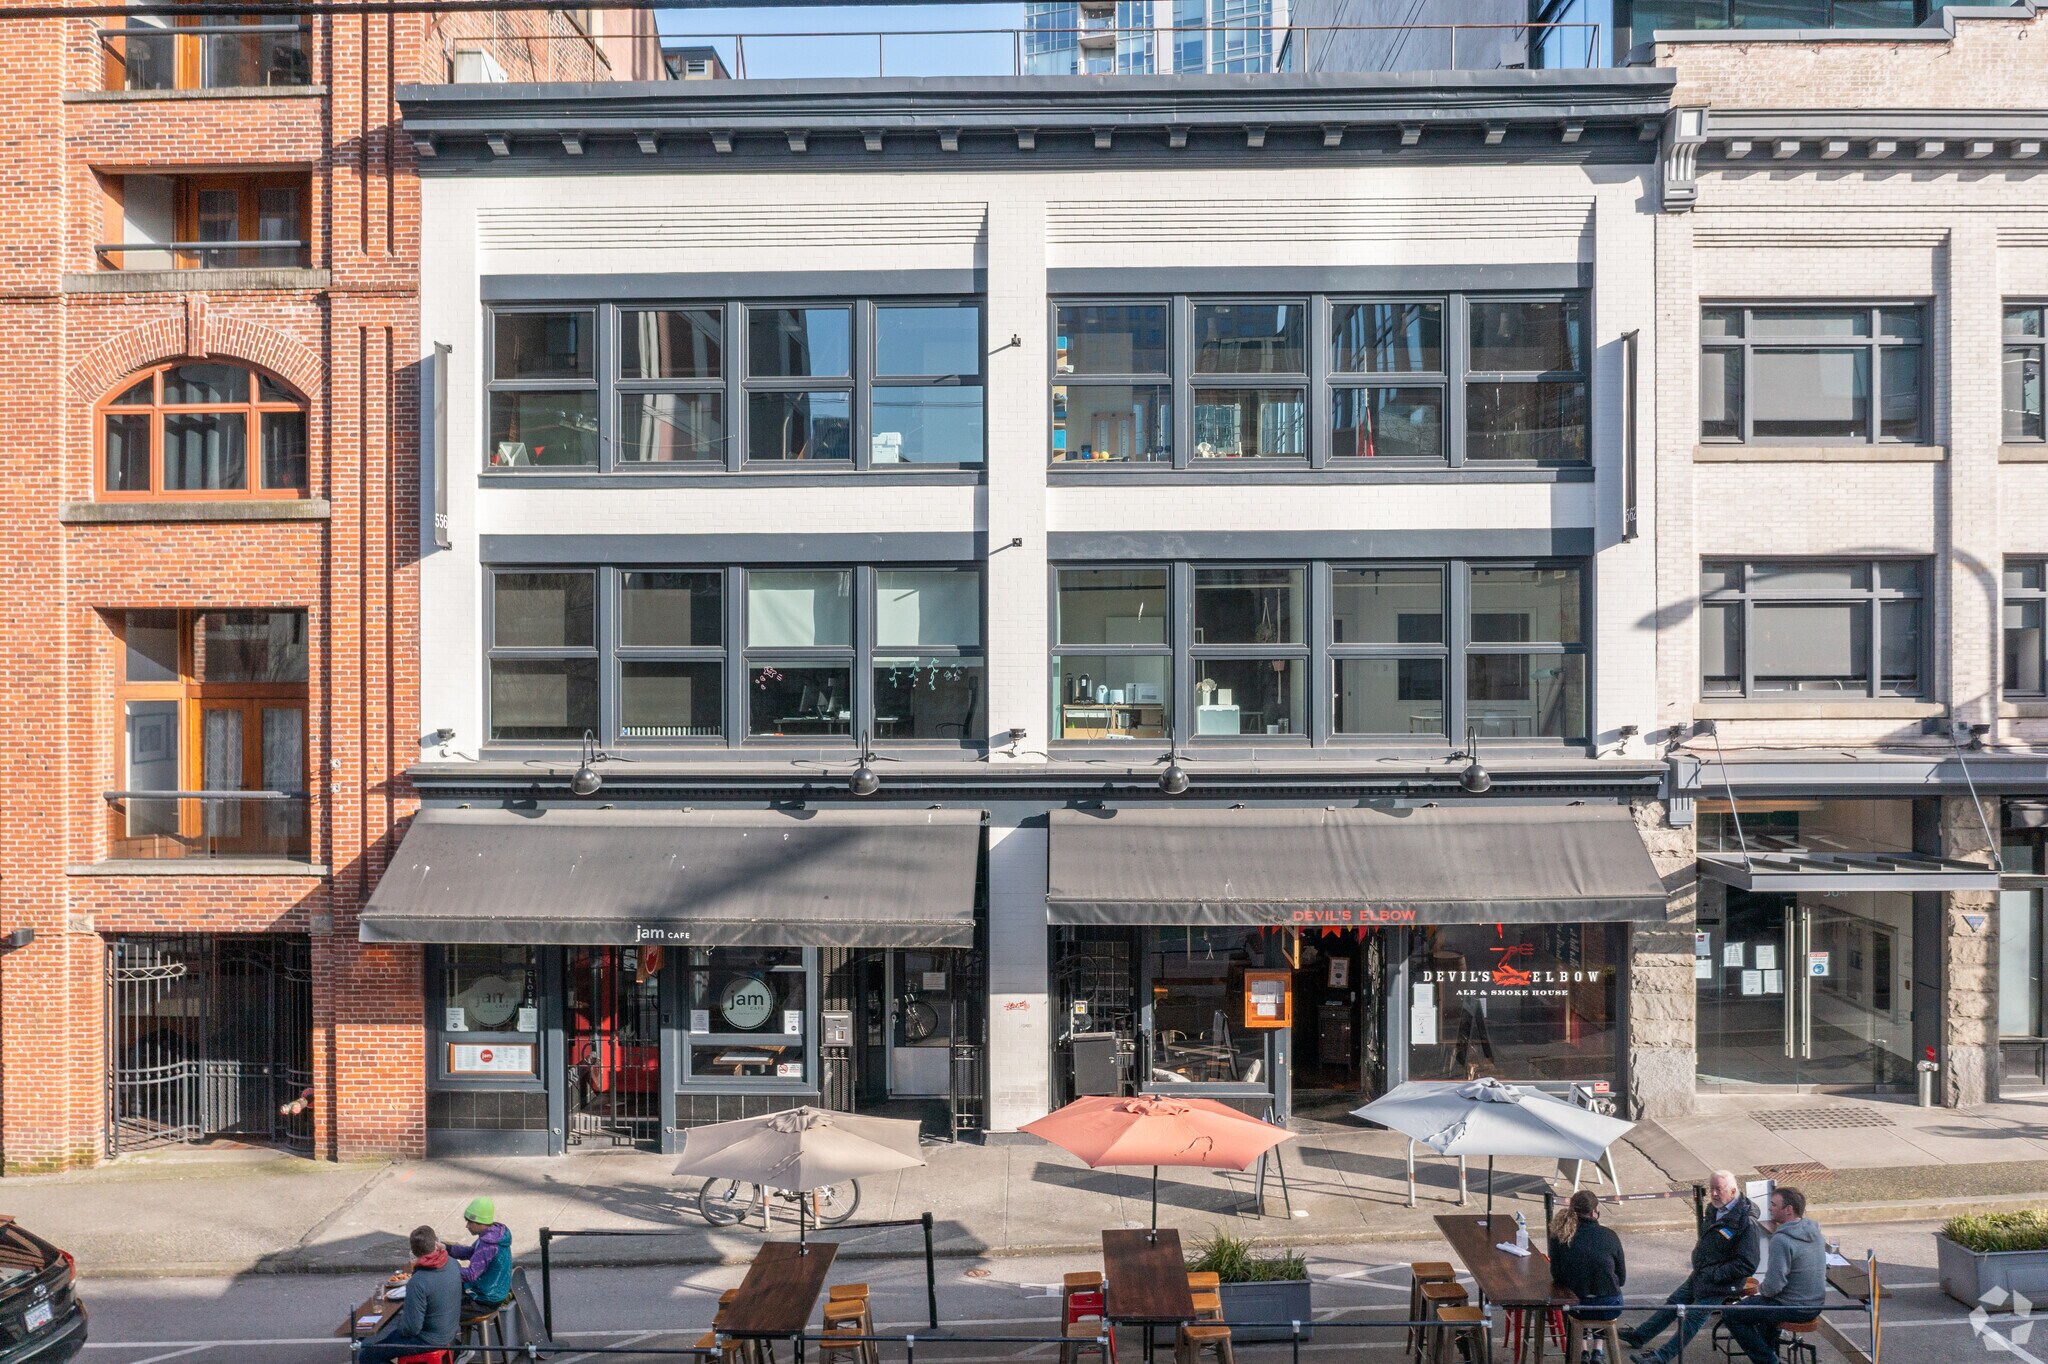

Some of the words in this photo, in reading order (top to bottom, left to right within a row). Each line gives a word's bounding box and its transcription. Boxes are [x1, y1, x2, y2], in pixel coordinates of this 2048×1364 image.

[435, 513, 448, 529] 556
[1293, 910, 1352, 921] DEVIL'S
[1359, 910, 1416, 921] ELBOW
[635, 924, 665, 943] jam
[1423, 970, 1490, 982] DEVIL'S
[1532, 970, 1600, 982] ELBOW
[729, 990, 764, 1010] jam
